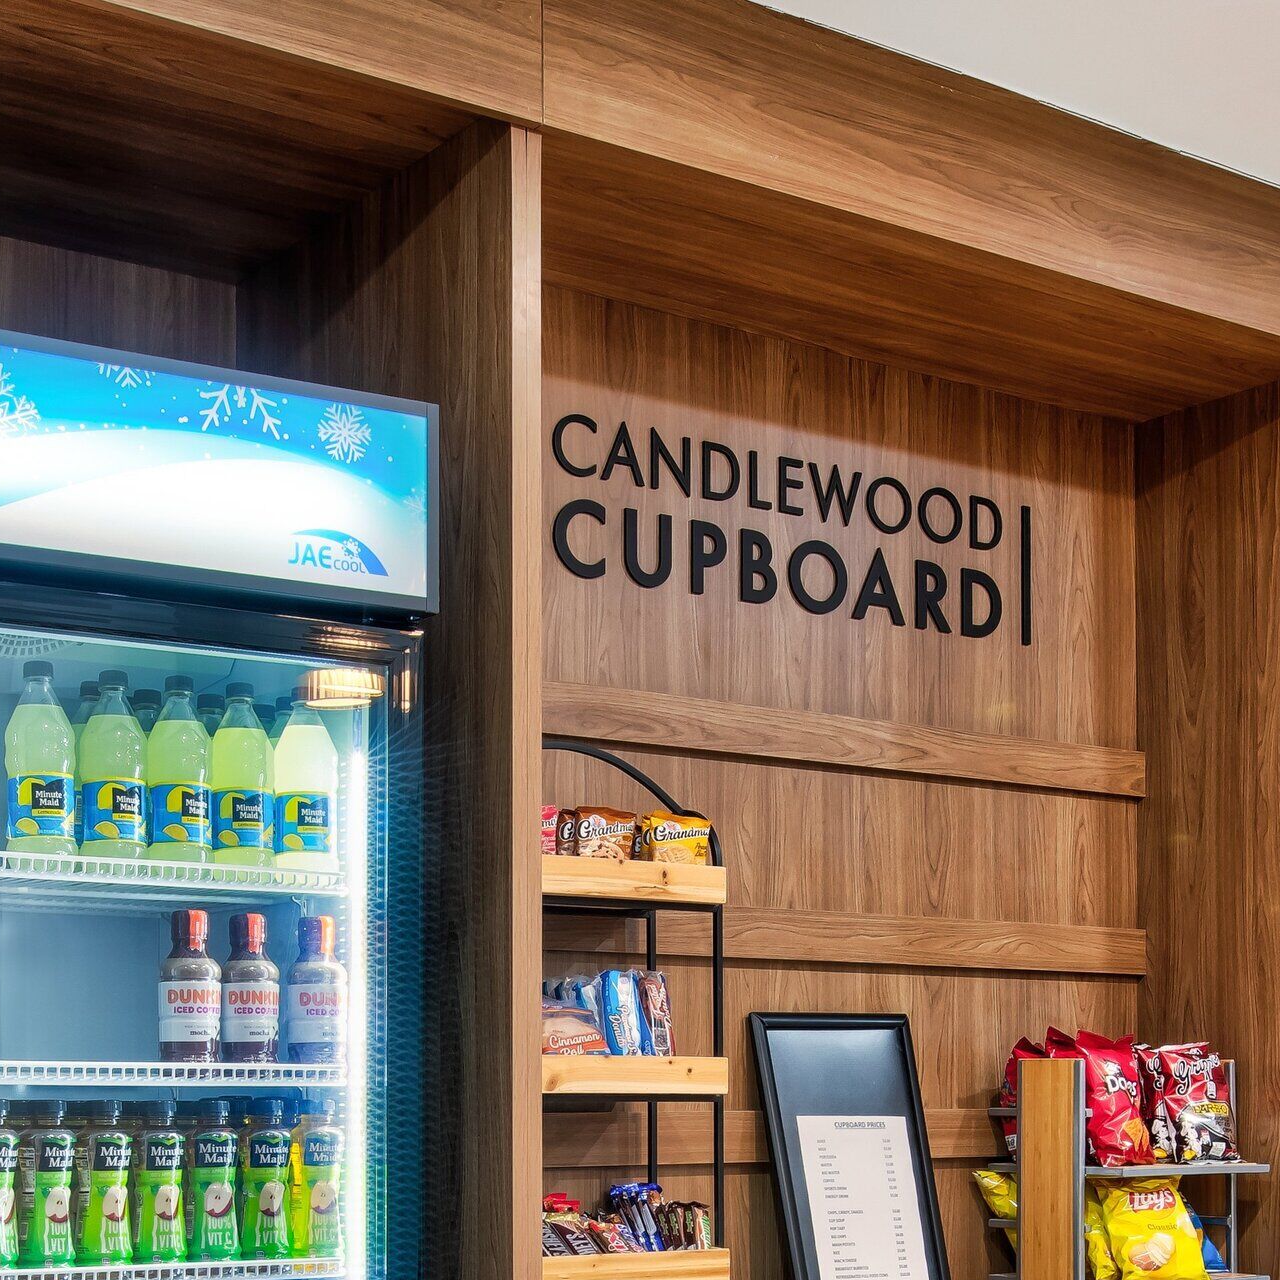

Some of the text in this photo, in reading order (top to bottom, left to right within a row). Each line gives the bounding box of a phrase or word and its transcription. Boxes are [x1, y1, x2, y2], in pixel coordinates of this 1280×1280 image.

[551, 414, 1003, 551] CANDLEWOOD
[552, 498, 1003, 639] CUPBOARD
[35, 789, 63, 799] Minute
[39, 797, 60, 807] Maid
[115, 795, 141, 804] Minute
[185, 798, 208, 808] Minute
[119, 802, 139, 812] Maid
[188, 806, 206, 815] Maid
[236, 804, 263, 813] Minute
[239, 811, 259, 820] Maid
[301, 808, 326, 817] Minute
[304, 815, 324, 824] Maid
[173, 1006, 195, 1014] ICED
[234, 1007, 254, 1015] ICED
[306, 1008, 327, 1016] ICED
[549, 1032, 600, 1049] Cinnamon
[199, 1143, 237, 1153] Minute
[259, 1153, 286, 1164] Maid
[1147, 1222, 1178, 1231] Classic
